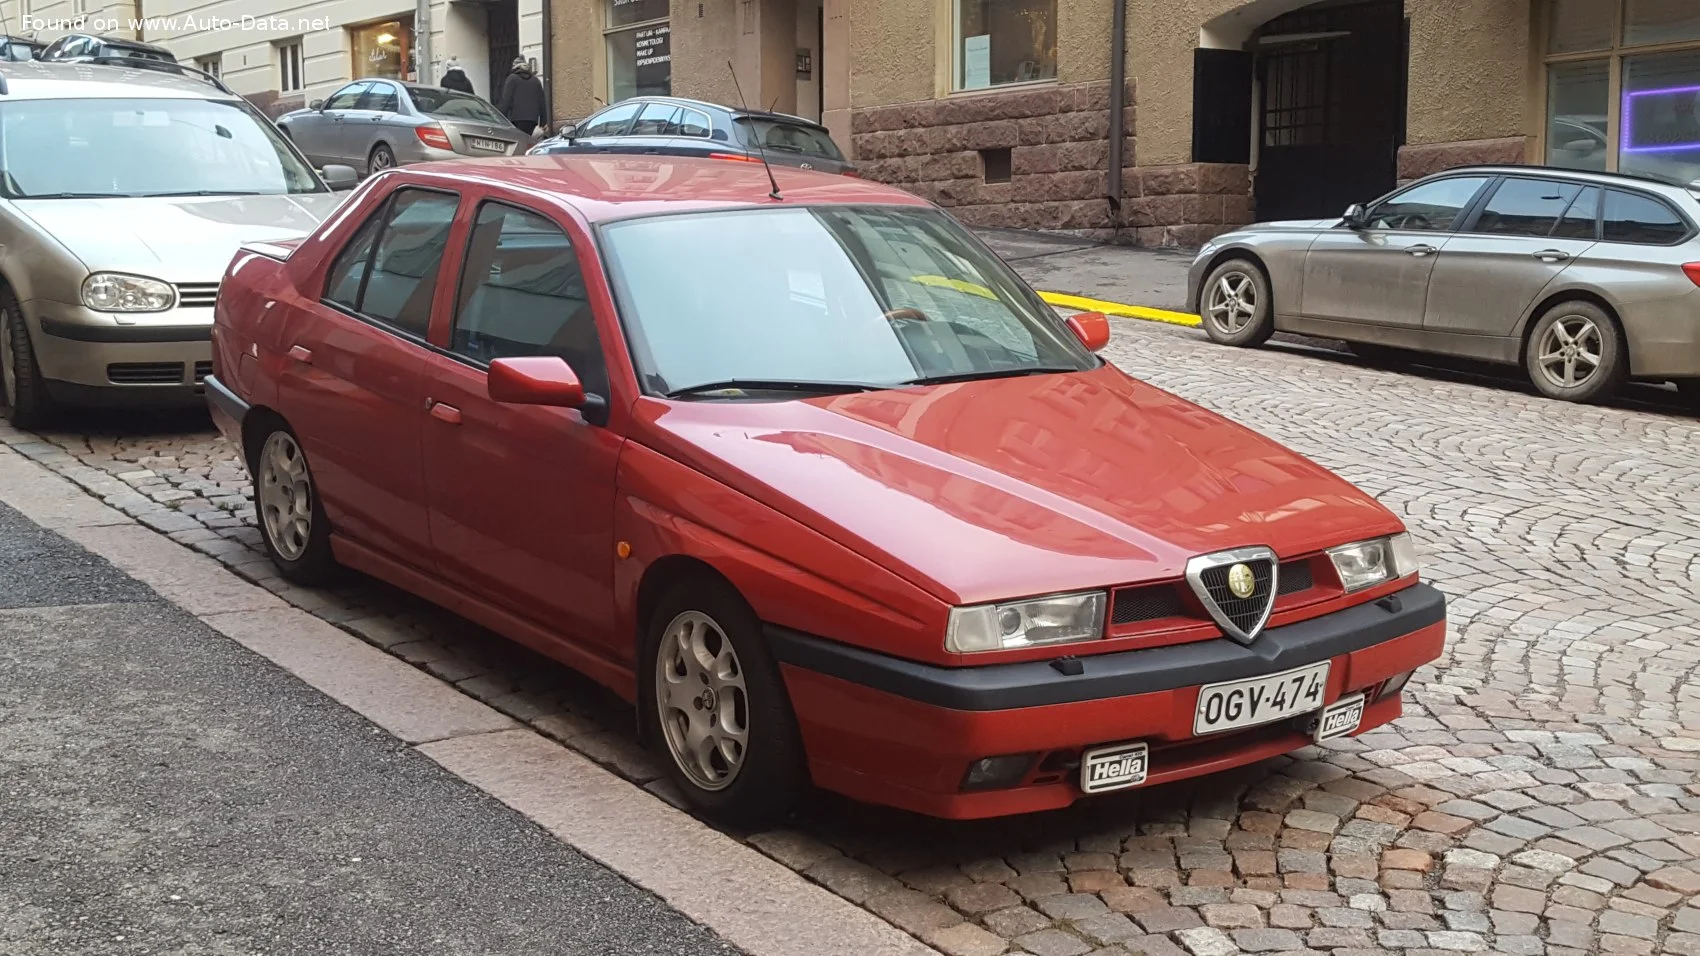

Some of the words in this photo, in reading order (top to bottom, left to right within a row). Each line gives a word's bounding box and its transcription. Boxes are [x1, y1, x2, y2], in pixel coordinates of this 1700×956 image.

[636, 49, 648, 57] MAKE
[1205, 672, 1319, 724] OGV-474
[1325, 708, 1360, 731] Hella
[1094, 758, 1142, 780] Hella
